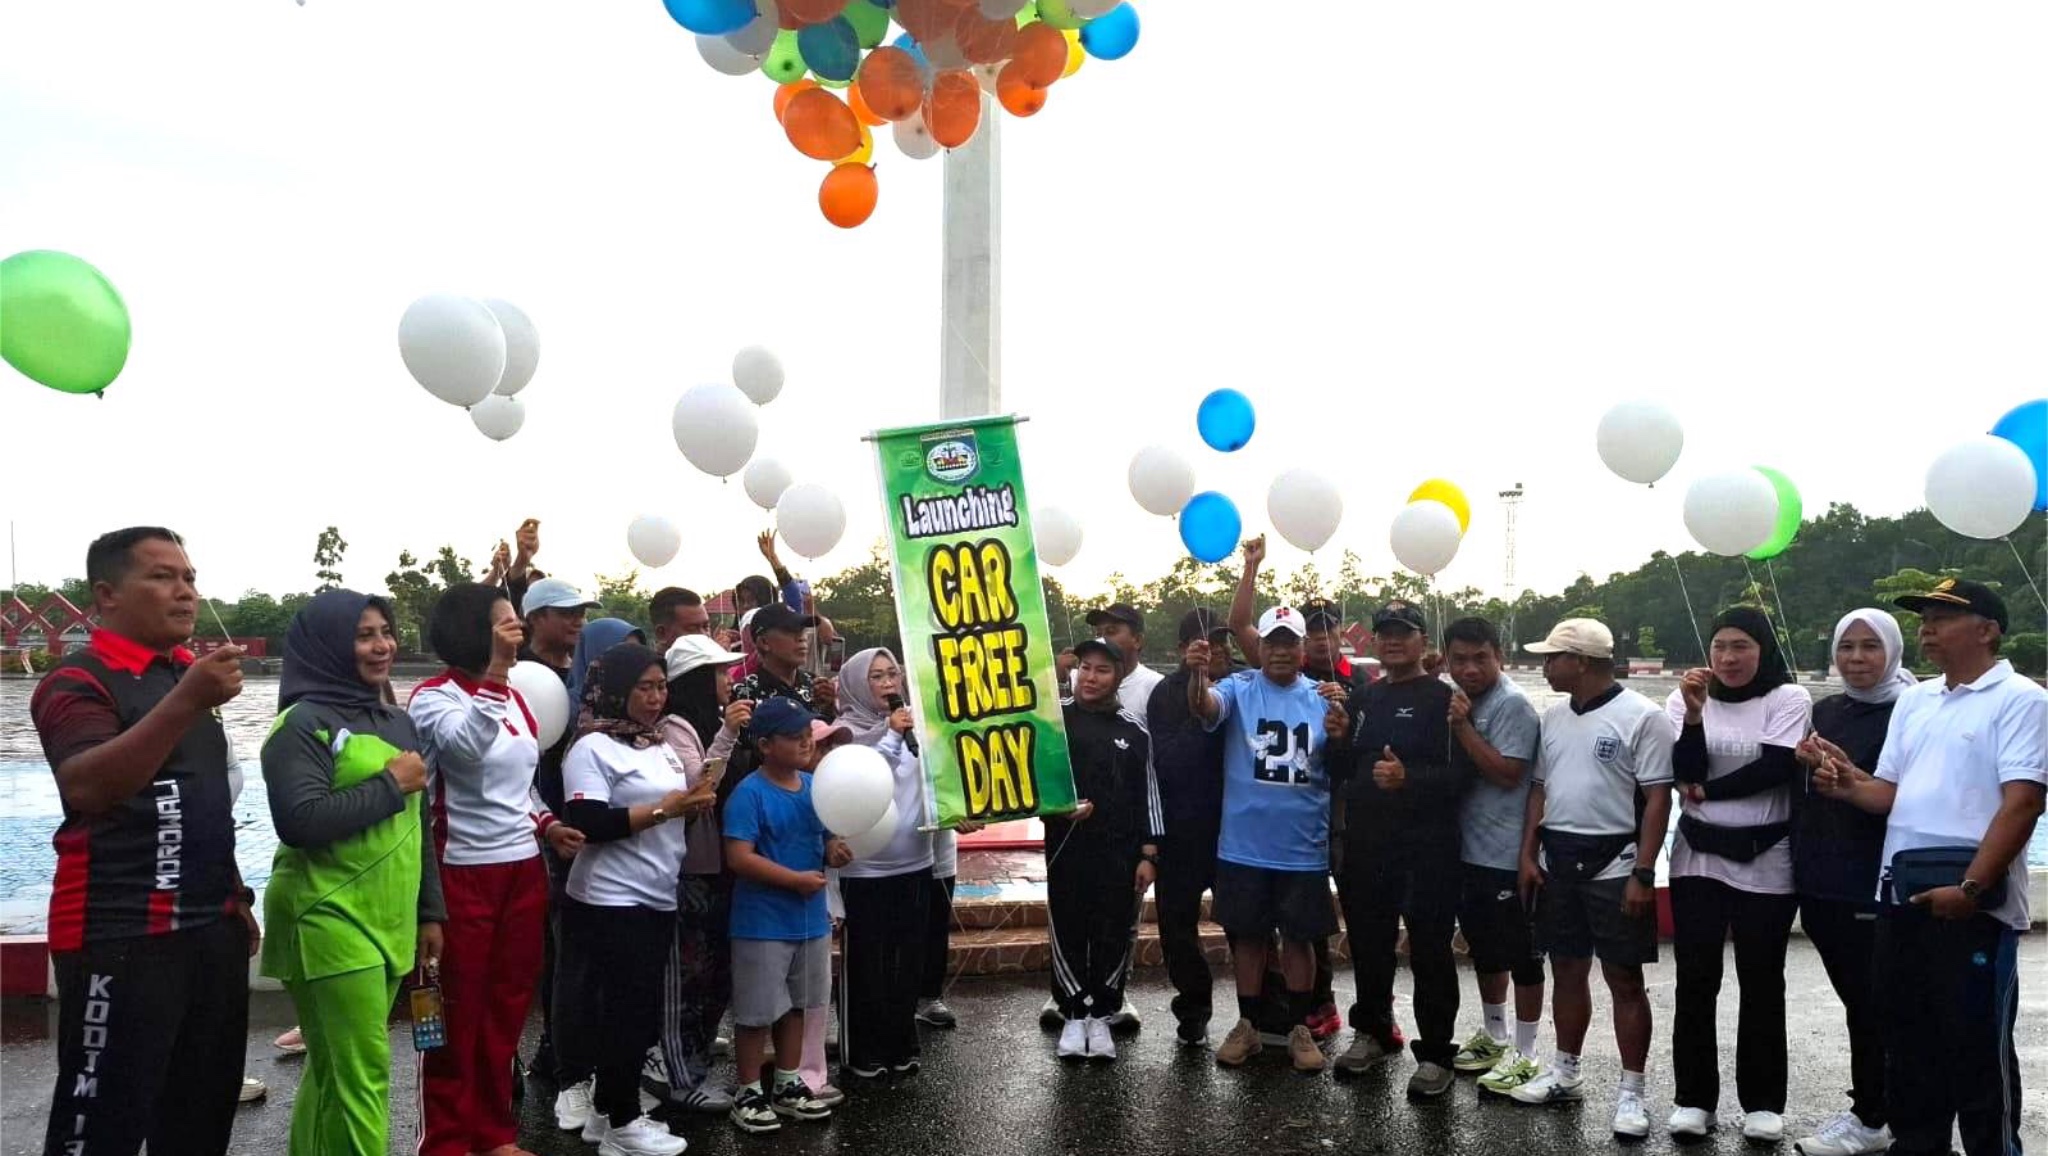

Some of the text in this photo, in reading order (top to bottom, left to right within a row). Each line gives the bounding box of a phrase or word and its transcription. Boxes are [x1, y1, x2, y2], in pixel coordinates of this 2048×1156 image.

[901, 484, 1017, 537] Launching
[931, 541, 1016, 630] CAR
[935, 627, 1034, 720] FREE
[958, 725, 1036, 816] DAY
[1254, 718, 1312, 785] 21
[153, 779, 182, 889] MOROWALI
[73, 974, 113, 1097] KODIM
